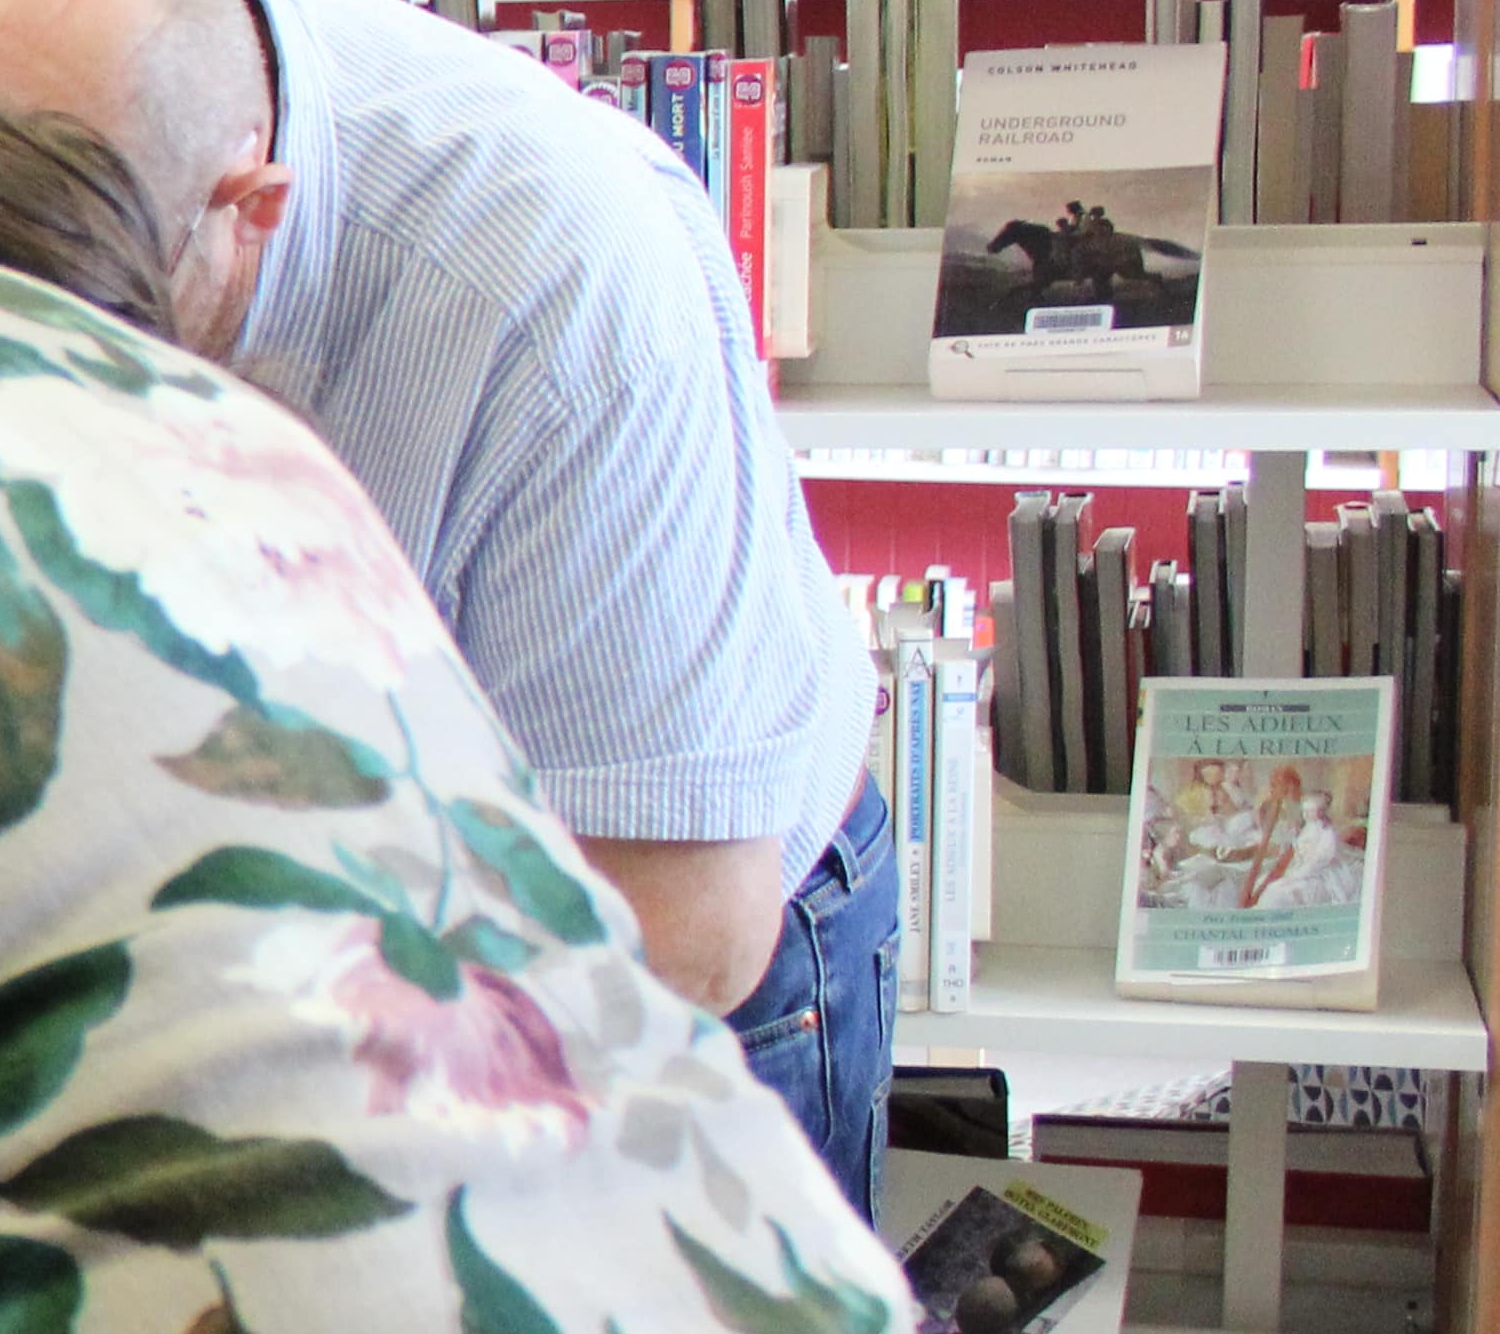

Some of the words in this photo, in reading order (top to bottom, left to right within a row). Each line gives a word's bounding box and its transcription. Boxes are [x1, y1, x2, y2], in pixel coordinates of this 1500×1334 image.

[988, 65, 1044, 75] COLSON
[1051, 61, 1138, 72] WHITEHEAD
[672, 93, 685, 137] MORT
[980, 114, 1127, 130] UNDERGROUND
[978, 131, 1075, 146] RAILROAD
[1185, 714, 1230, 732] LES
[1243, 714, 1344, 732] ADIEUX
[1187, 735, 1203, 755] À
[1216, 738, 1248, 755] LA
[1260, 737, 1340, 755] REINE
[908, 766, 923, 842] PORTRAITS
[907, 904, 921, 934] JANE
